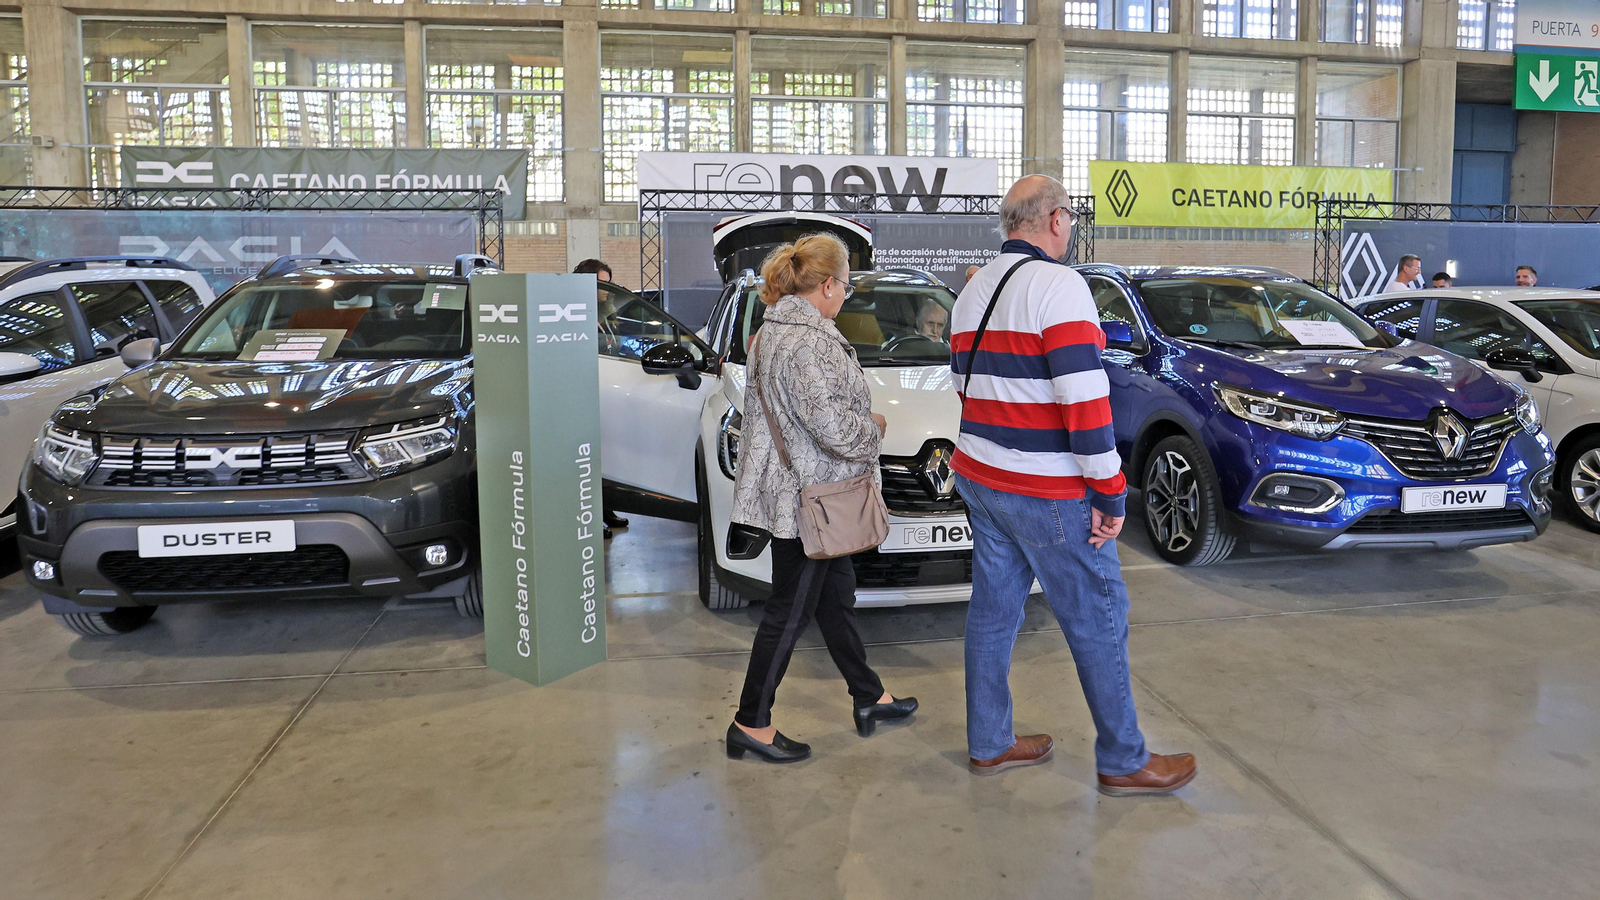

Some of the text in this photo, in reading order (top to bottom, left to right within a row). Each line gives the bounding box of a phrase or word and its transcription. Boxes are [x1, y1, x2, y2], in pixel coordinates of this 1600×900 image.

[1532, 20, 1599, 37] PUERTA 9
[229, 168, 512, 196] CAETANO FÓRMULA
[693, 163, 948, 212] renew
[1172, 186, 1378, 210] CAETANO FÓRMULA
[119, 235, 361, 262] DACIA
[888, 248, 899, 256] de
[901, 248, 935, 256] ocasión
[949, 249, 982, 257] Renault
[876, 256, 924, 264] dicionados
[926, 258, 931, 266] y
[213, 267, 257, 275] ELIGE
[478, 333, 520, 343] DACIA
[536, 332, 589, 343] DACIA
[1421, 489, 1487, 507] renew
[163, 531, 271, 548] DUSTER
[575, 443, 597, 643] Caetano Fórmula
[509, 450, 531, 657] Caetano Fórmula
